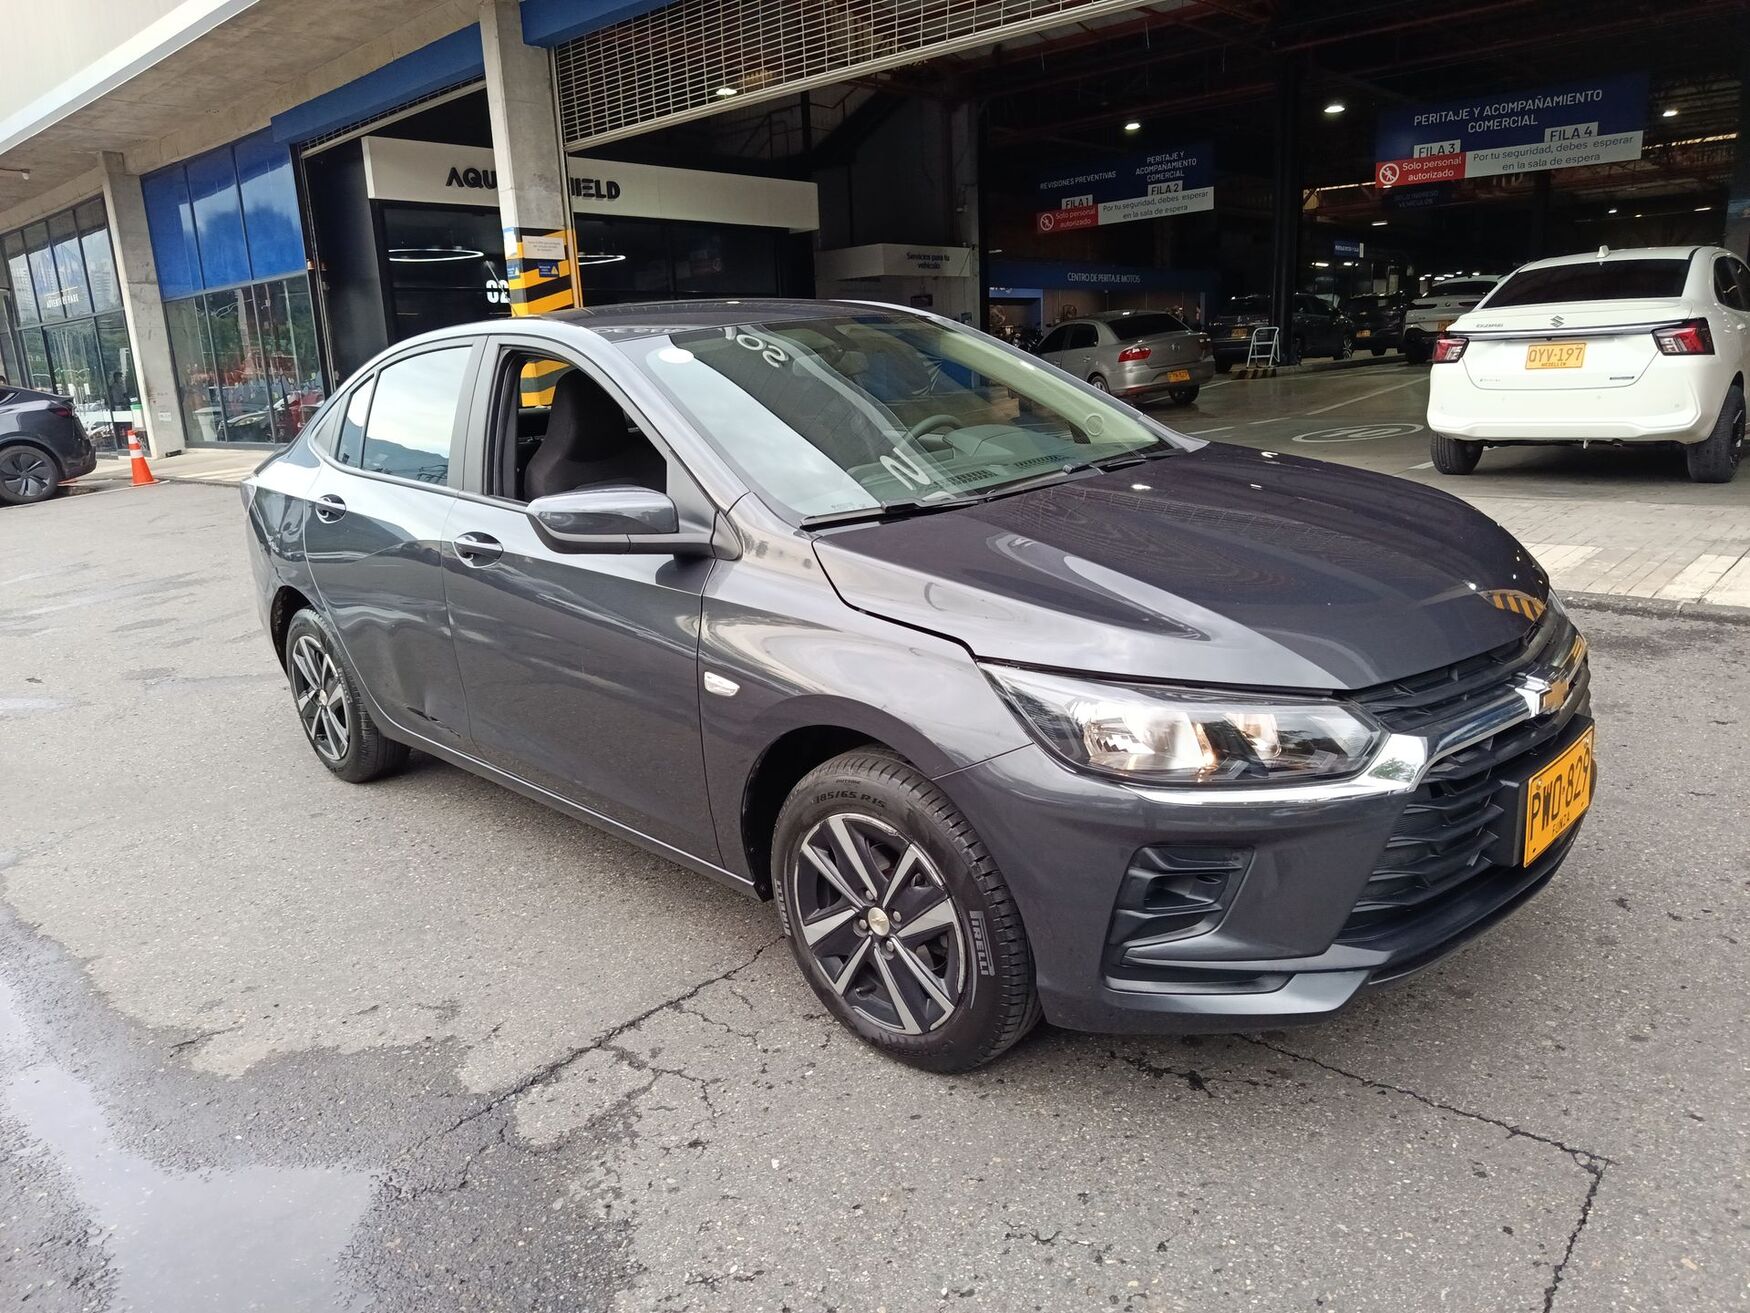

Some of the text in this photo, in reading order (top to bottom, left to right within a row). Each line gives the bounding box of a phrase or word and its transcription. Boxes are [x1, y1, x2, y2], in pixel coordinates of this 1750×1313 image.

[1414, 89, 1603, 126] PERITAJE Y ACOMPAÑAMIENTO
[1468, 114, 1538, 133] COMERCIAL
[1550, 126, 1592, 142] FILA 4
[1419, 143, 1456, 157] FILA 3
[1474, 136, 1633, 161] Por tu seguridad, debes esperar
[1147, 152, 1179, 164] PERITAJE
[1402, 156, 1462, 171] Solo personal
[1502, 153, 1600, 171] en la sala de espera
[1135, 158, 1197, 175] ACOMPAÑAMIENTO
[1040, 170, 1117, 190] REVISIONES PREVENTIVAS
[1147, 170, 1185, 182] COMERCIAL
[1408, 169, 1454, 181] autorizado
[1151, 183, 1179, 195] FILA 2
[1182, 191, 1209, 201] esperar
[1066, 198, 1084, 208] FILA
[1067, 272, 1090, 282] CENTRO
[1090, 272, 1098, 282] DE
[1121, 274, 1141, 284] MOTOS
[813, 790, 887, 808] 185/65 R15
[969, 910, 995, 976] PIRELLI
